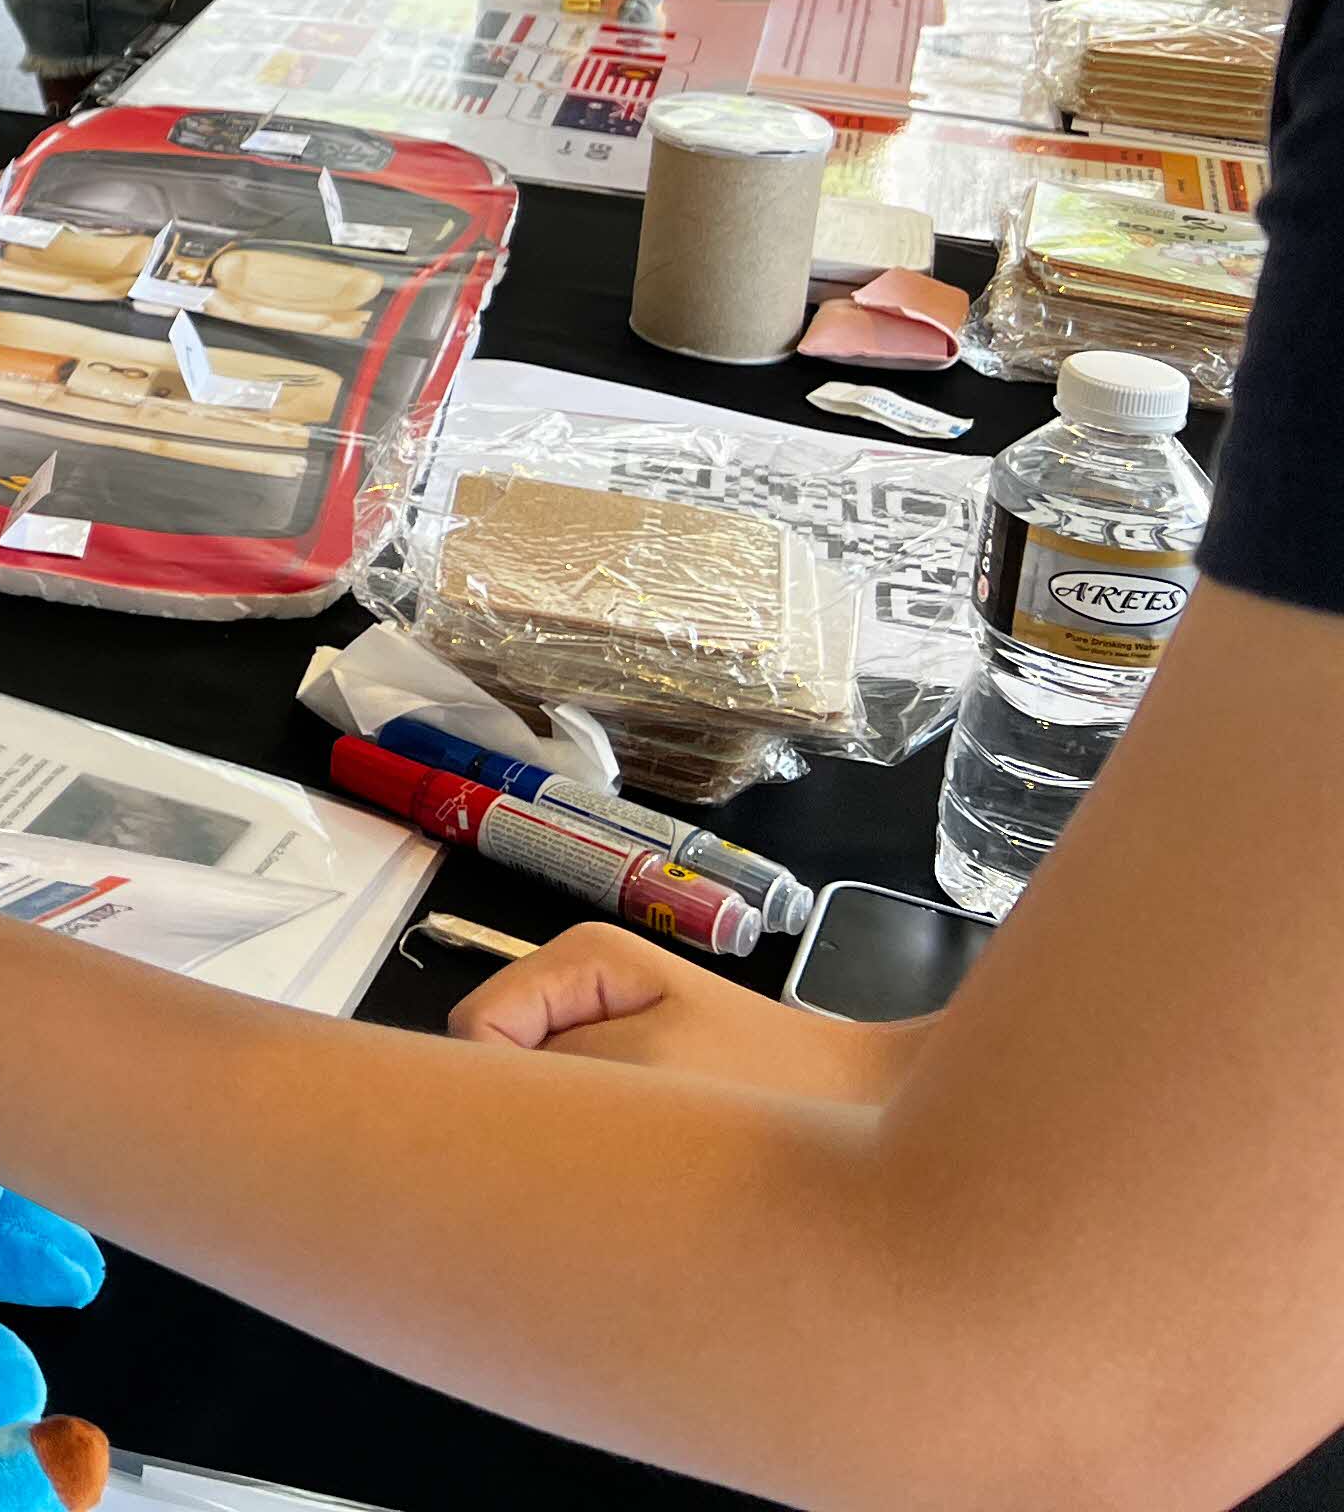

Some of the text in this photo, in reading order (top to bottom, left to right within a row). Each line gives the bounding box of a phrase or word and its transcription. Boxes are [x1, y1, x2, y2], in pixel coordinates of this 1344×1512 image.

[1055, 581, 1182, 614] AREES
[1065, 632, 1161, 651] Pure Drinking Water
